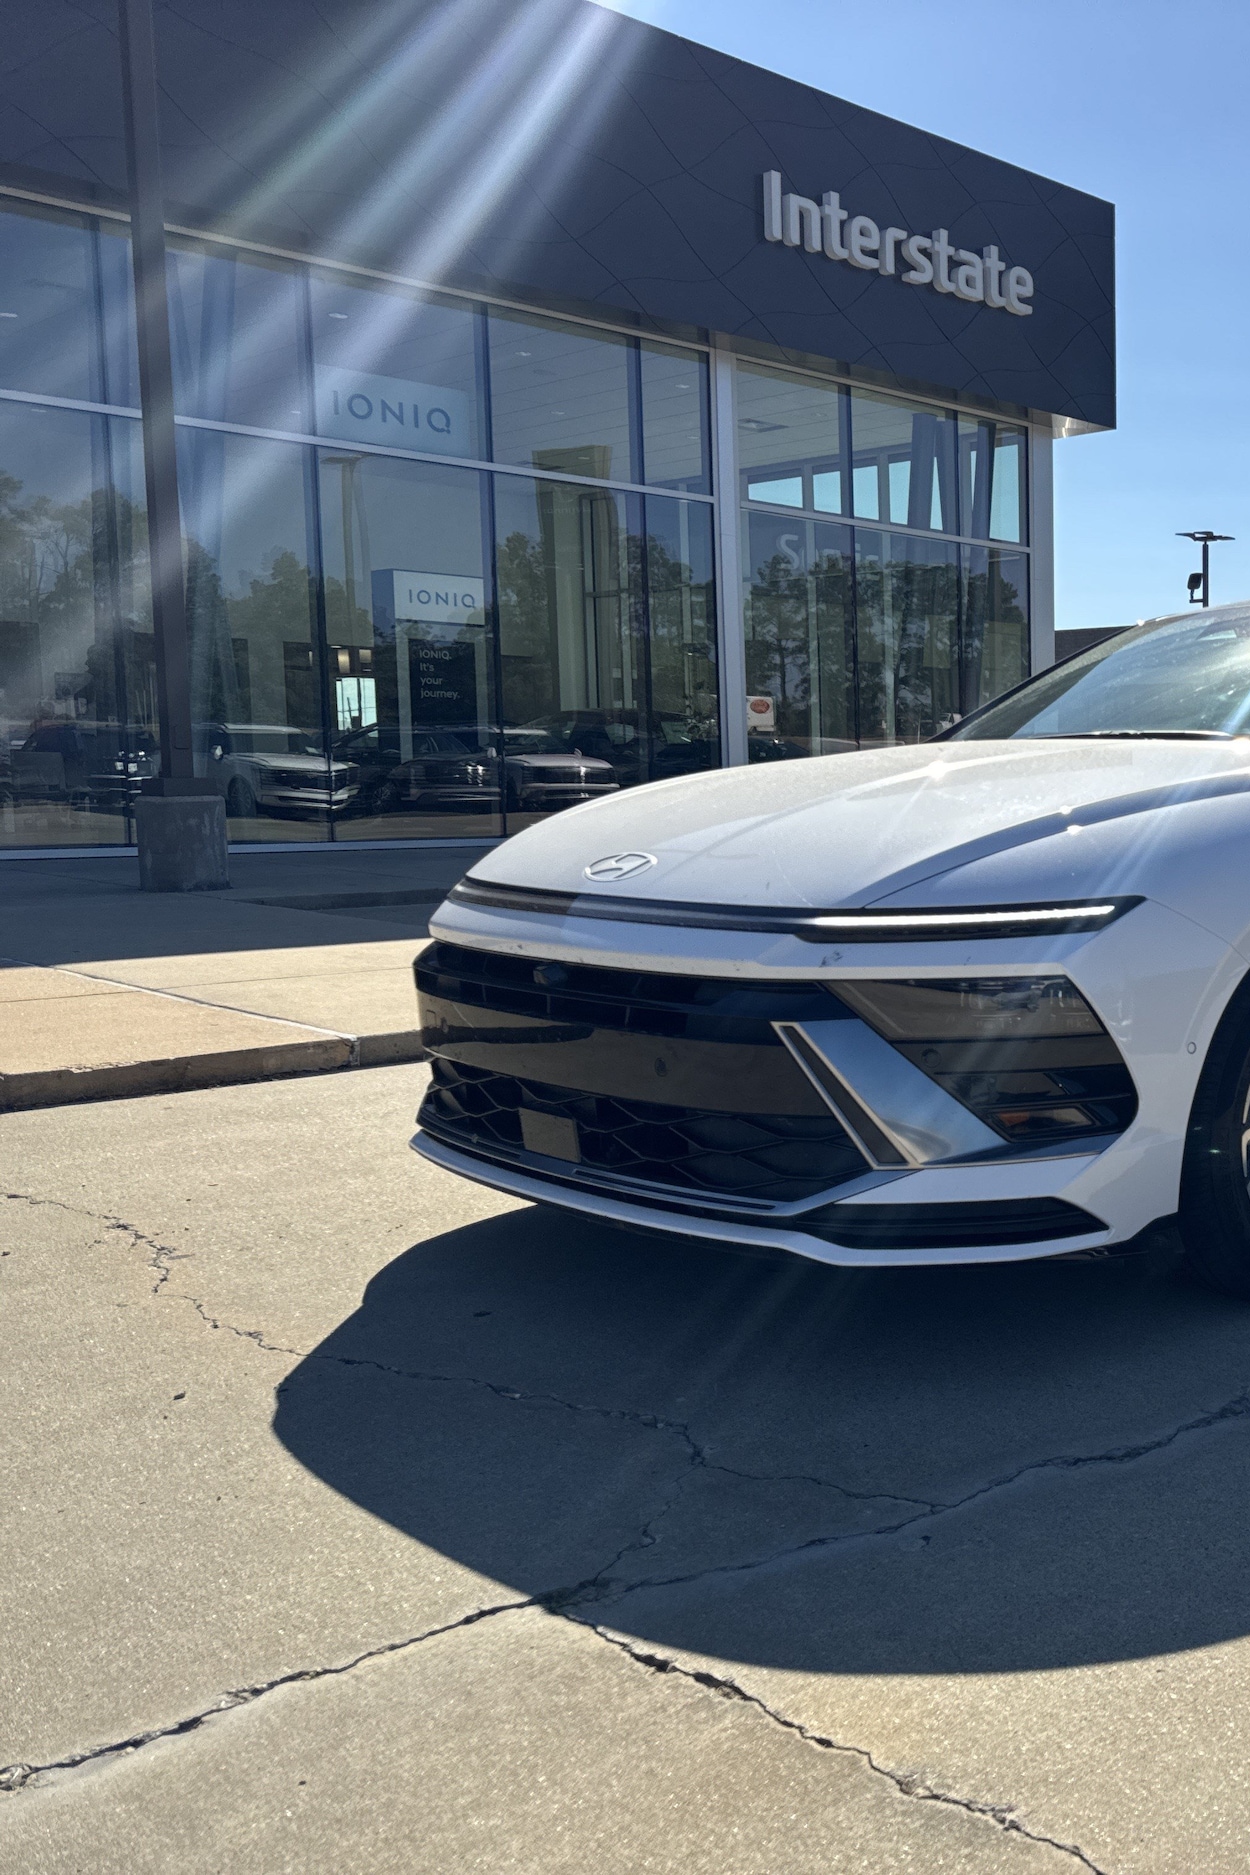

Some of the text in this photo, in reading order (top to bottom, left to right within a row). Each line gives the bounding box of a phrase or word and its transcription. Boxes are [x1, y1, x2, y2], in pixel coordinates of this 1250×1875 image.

[763, 170, 1034, 316] Interstate
[333, 390, 451, 434] IONIQ
[409, 589, 476, 609] IONIQ
[420, 649, 452, 660] IONIQ.
[420, 662, 435, 672] It's
[420, 676, 443, 686] your
[420, 688, 460, 700] journey.
